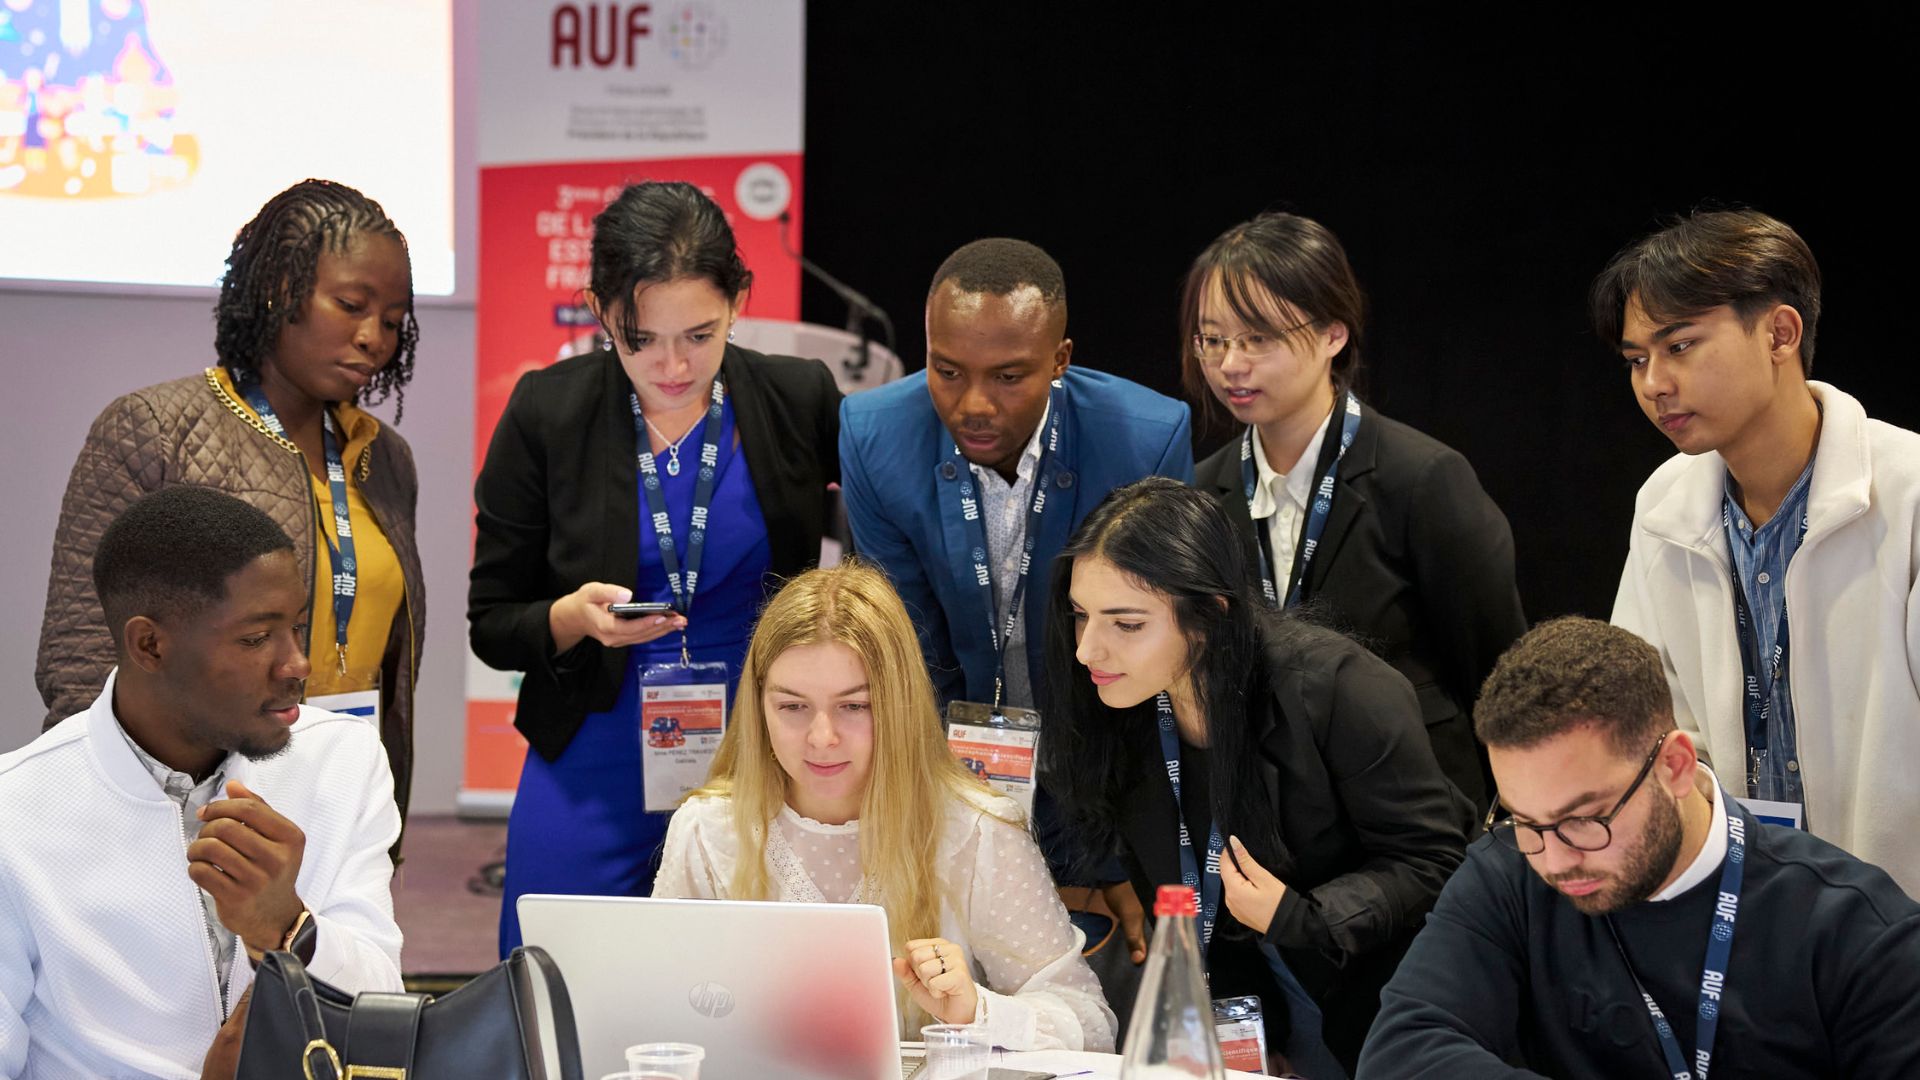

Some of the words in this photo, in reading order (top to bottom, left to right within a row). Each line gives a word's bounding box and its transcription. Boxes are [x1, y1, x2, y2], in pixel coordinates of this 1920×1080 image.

[551, 3, 651, 68] AUF
[712, 380, 724, 405] AUF
[260, 413, 284, 433] AUF
[1050, 427, 1058, 451] AUF
[638, 452, 657, 475] AUF
[701, 443, 718, 467] AUF
[327, 462, 345, 482] AUF
[1318, 475, 1335, 500] AUF
[961, 497, 979, 521] AUF
[1033, 489, 1046, 513] AUF
[335, 516, 352, 537] AUF
[653, 511, 671, 534] AUF
[691, 506, 708, 530] AUF
[1303, 538, 1317, 562] AUF
[975, 563, 990, 586] AUF
[1020, 551, 1031, 576] AUF
[342, 571, 356, 597] AUF
[668, 572, 682, 595] AUF
[686, 570, 698, 594] AUF
[1262, 578, 1276, 601] AUF
[1005, 614, 1016, 637] AUF
[1747, 675, 1761, 699] AUF
[1156, 691, 1172, 714] AUF
[953, 729, 967, 738] AUF
[1166, 760, 1180, 784] AUF
[1728, 816, 1745, 846] AUF
[1206, 849, 1222, 874] AUF
[1716, 891, 1738, 923] AUF
[1203, 920, 1214, 944] AUF
[1701, 969, 1724, 1001] AUF
[1642, 992, 1665, 1019] AUF
[1696, 1048, 1711, 1080] AUF
